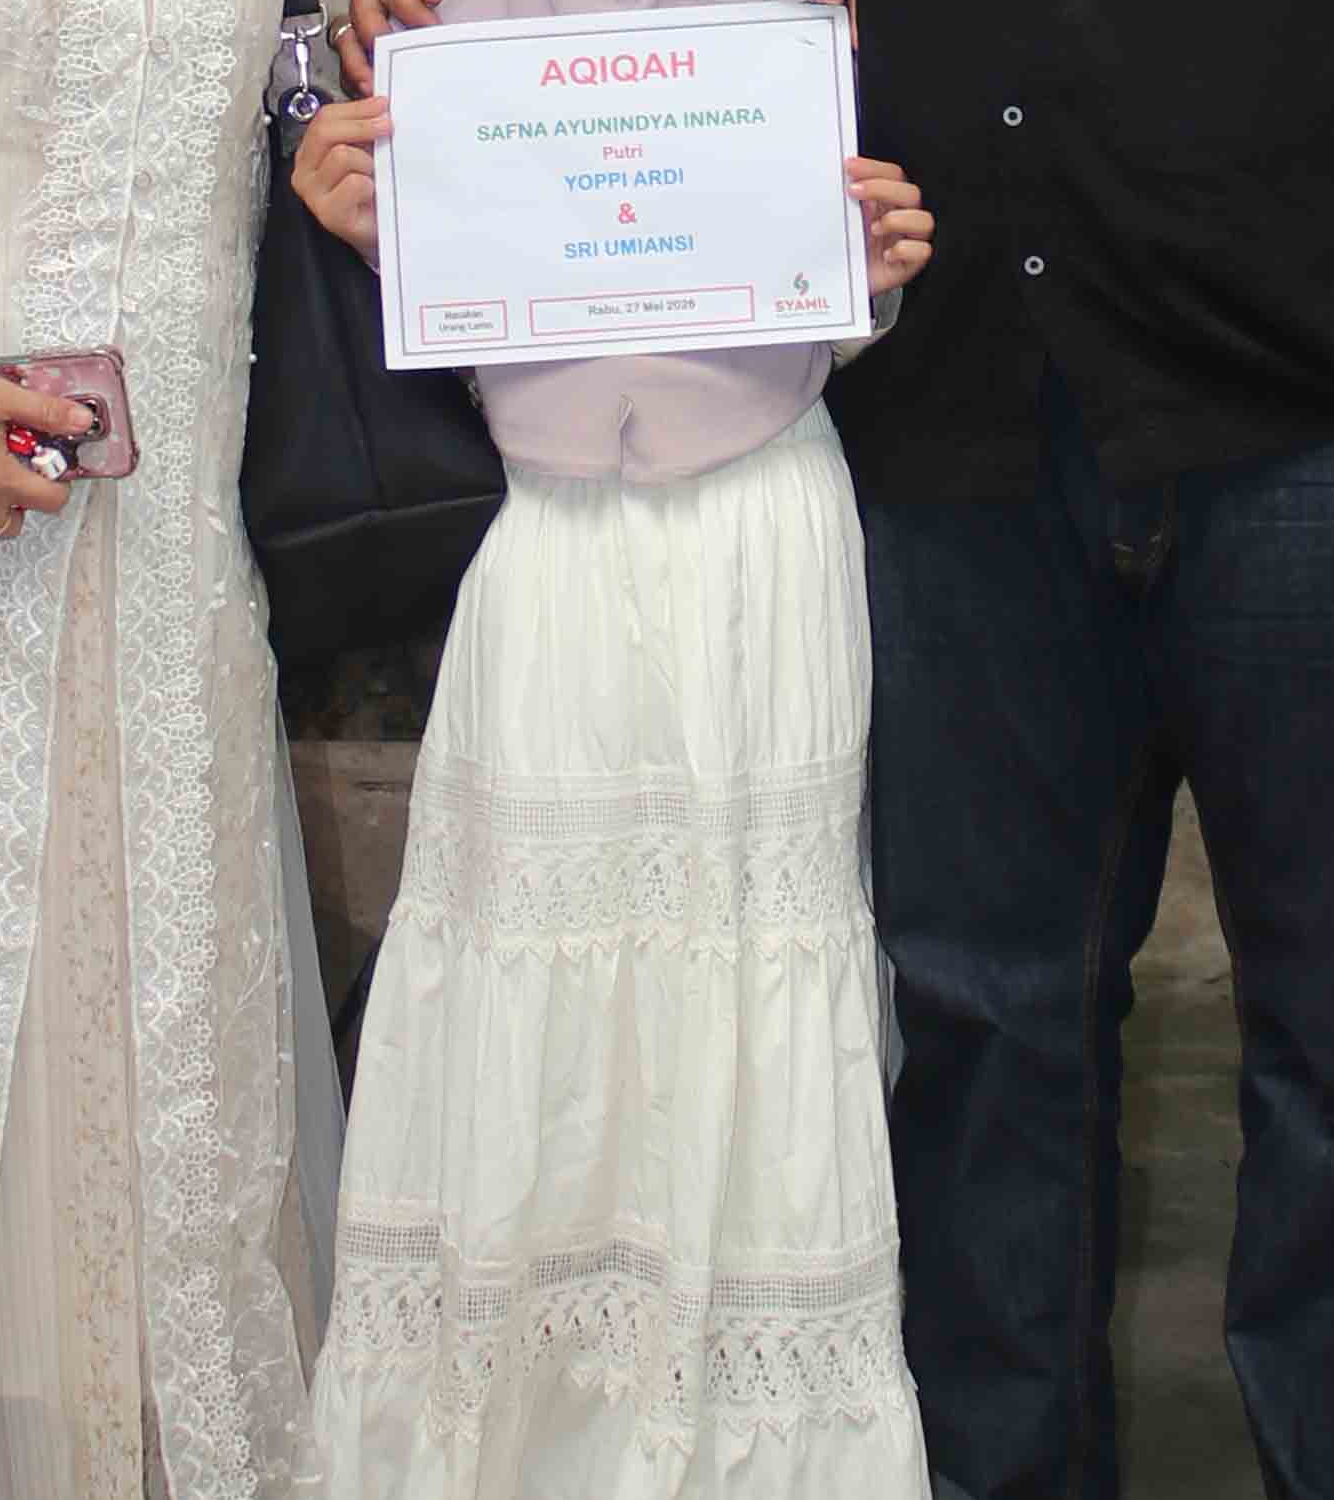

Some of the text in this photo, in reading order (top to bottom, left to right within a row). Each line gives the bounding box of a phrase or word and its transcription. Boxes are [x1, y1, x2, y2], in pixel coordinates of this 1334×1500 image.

[540, 49, 696, 87] AQIQAH
[477, 107, 766, 142] SAFNA AYUNINDYA INNARA
[603, 144, 643, 160] Putri
[564, 167, 684, 192] YOPPI ARDI
[618, 202, 637, 224] &
[564, 234, 694, 259] SRI UMIANSI
